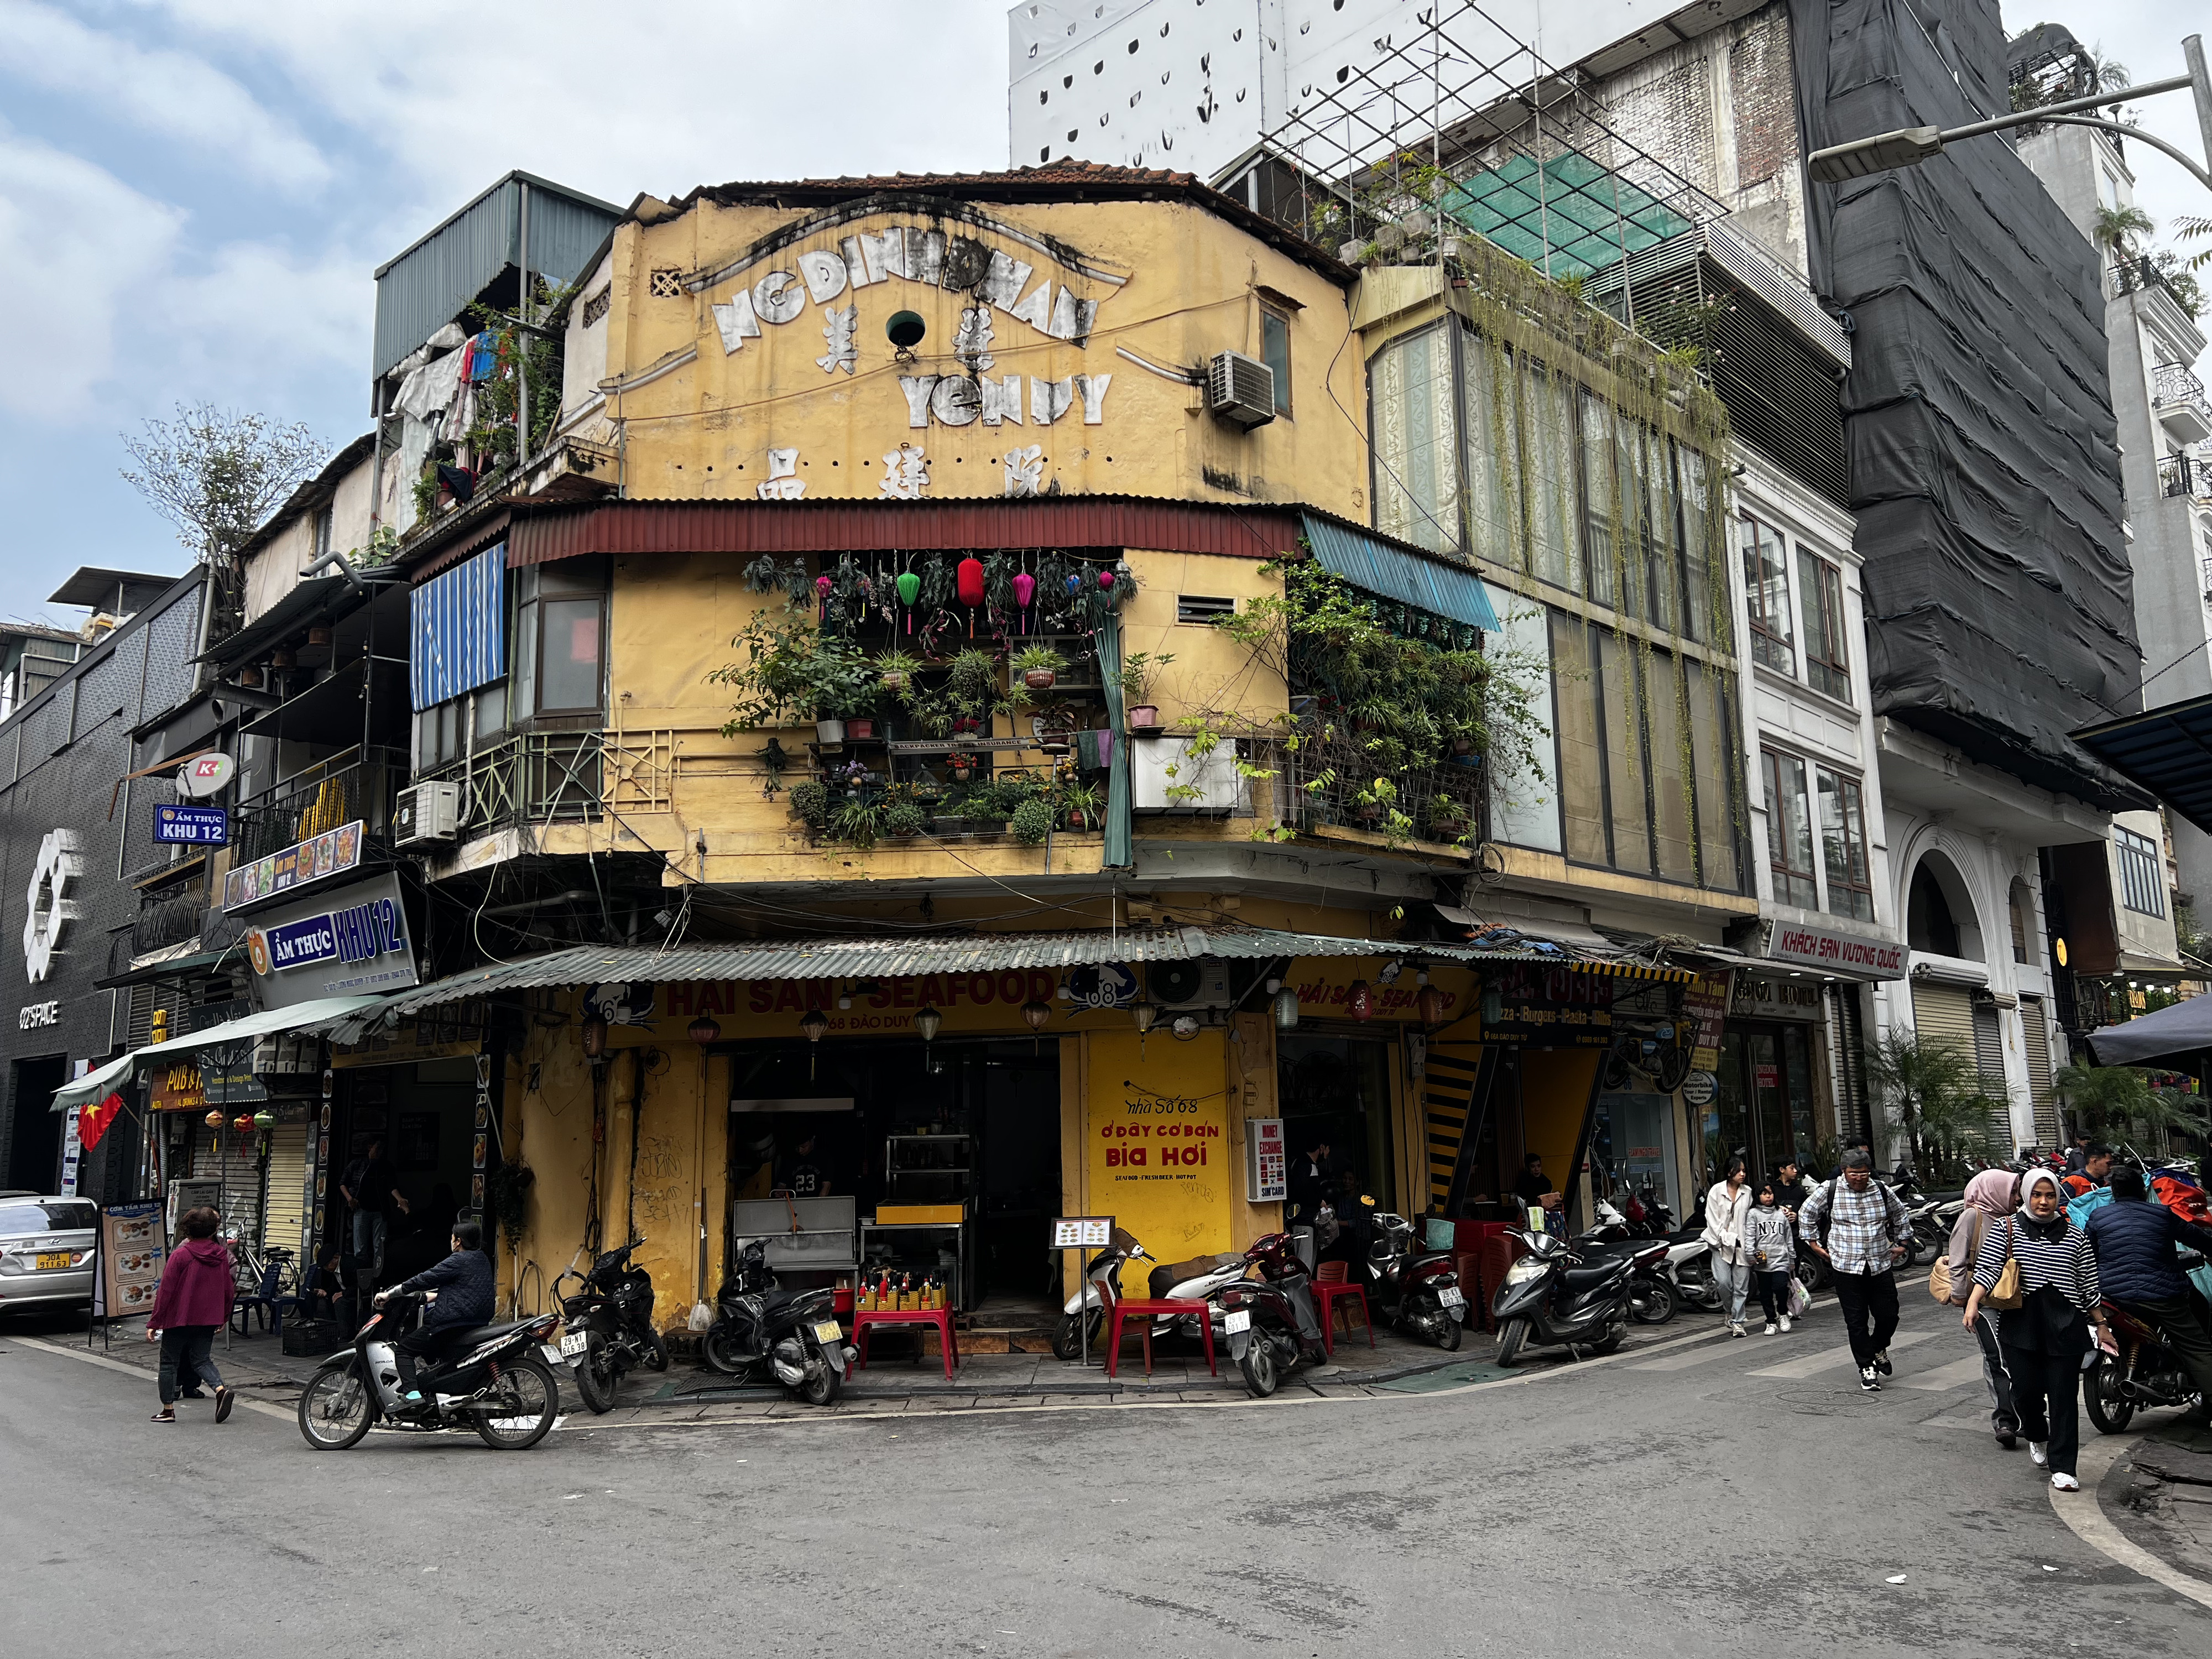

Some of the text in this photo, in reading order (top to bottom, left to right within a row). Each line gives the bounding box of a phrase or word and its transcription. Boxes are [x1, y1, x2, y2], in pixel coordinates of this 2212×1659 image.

[195, 815, 222, 823] THỰC
[163, 824, 222, 839] KHU 12
[275, 897, 402, 964] ẨM THỰC KHU 12
[1781, 929, 1901, 969] KHÁCH SẠN VƯƠNG QUỐC
[868, 971, 1054, 1008] SEAFOOD
[1297, 978, 1328, 1004] HẢI
[1708, 980, 1725, 997] Tâm
[829, 1014, 910, 1030] 68 ĐÀO DUY
[1521, 1005, 1556, 1026] Burgers
[1562, 1008, 1587, 1024] Pasta
[1593, 1010, 1611, 1026] Ribs
[1698, 1034, 1710, 1046] DUY
[166, 1065, 187, 1092] PUB
[1177, 1099, 1198, 1114] 68
[1262, 1125, 1277, 1138] MONEY
[1260, 1141, 1282, 1155] EXCHANGE
[796, 1174, 815, 1192] 23
[1261, 1186, 1284, 1197] SIM CARD
